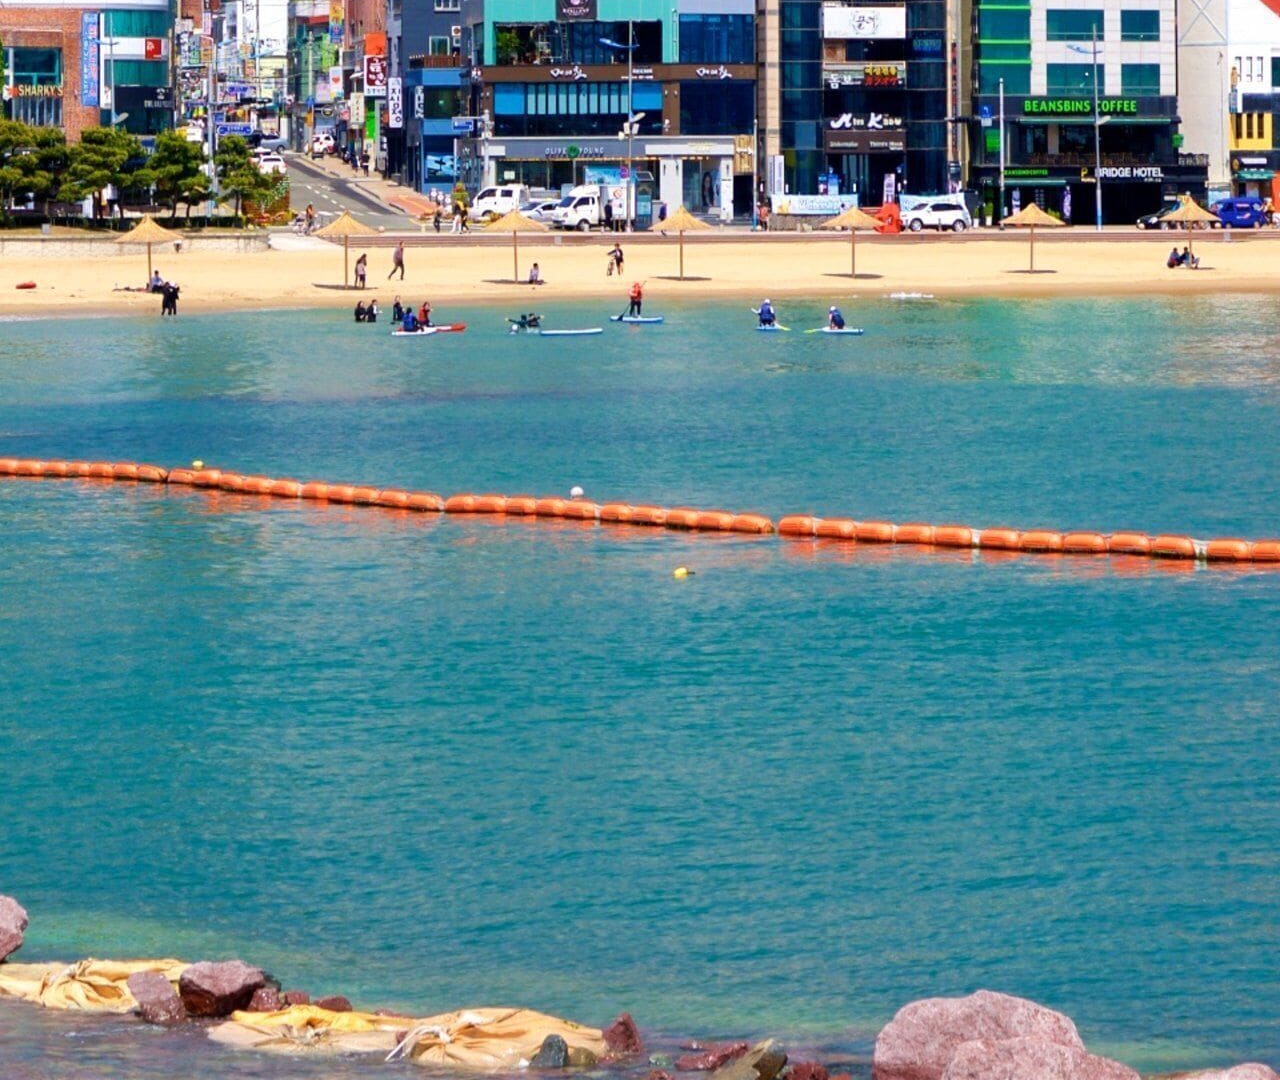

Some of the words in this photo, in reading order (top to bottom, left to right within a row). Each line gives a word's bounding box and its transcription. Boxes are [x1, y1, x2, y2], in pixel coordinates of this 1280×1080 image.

[19, 85, 63, 97] SHARKY'S
[1024, 100, 1091, 113] BEANSBINS
[1132, 167, 1164, 178] HOTEL
